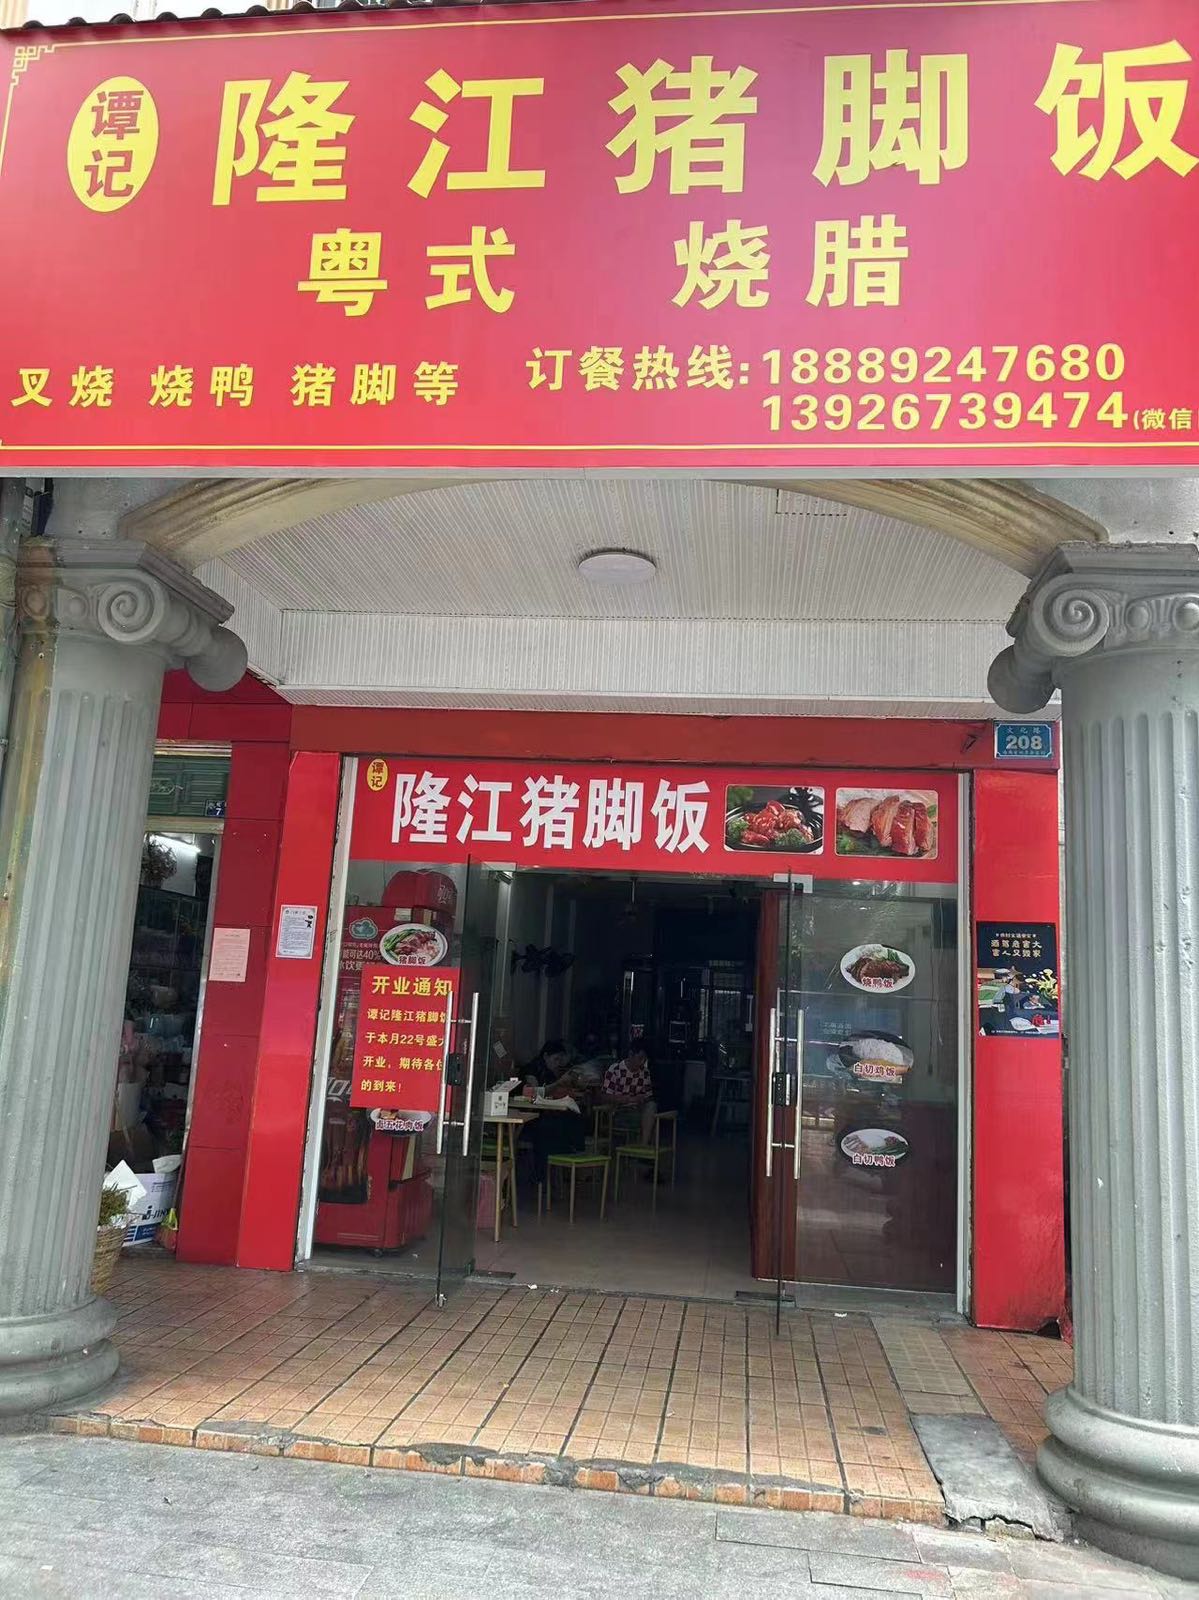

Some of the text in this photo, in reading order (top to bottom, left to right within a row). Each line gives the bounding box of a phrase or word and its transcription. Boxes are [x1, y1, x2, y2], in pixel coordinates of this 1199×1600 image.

[212, 40, 1199, 205] 隆江猪脚饭
[84, 89, 144, 198] 谭记
[298, 214, 908, 316] 粤式 烧腊
[1006, 735, 1042, 750] 208
[391, 770, 711, 853] 隆江猪脚饭
[372, 976, 453, 996] 开业通知
[862, 977, 894, 989] 烧鸭饭
[853, 1062, 896, 1077] 白切鸡饭
[853, 1153, 896, 1167] 白切鸭饭
